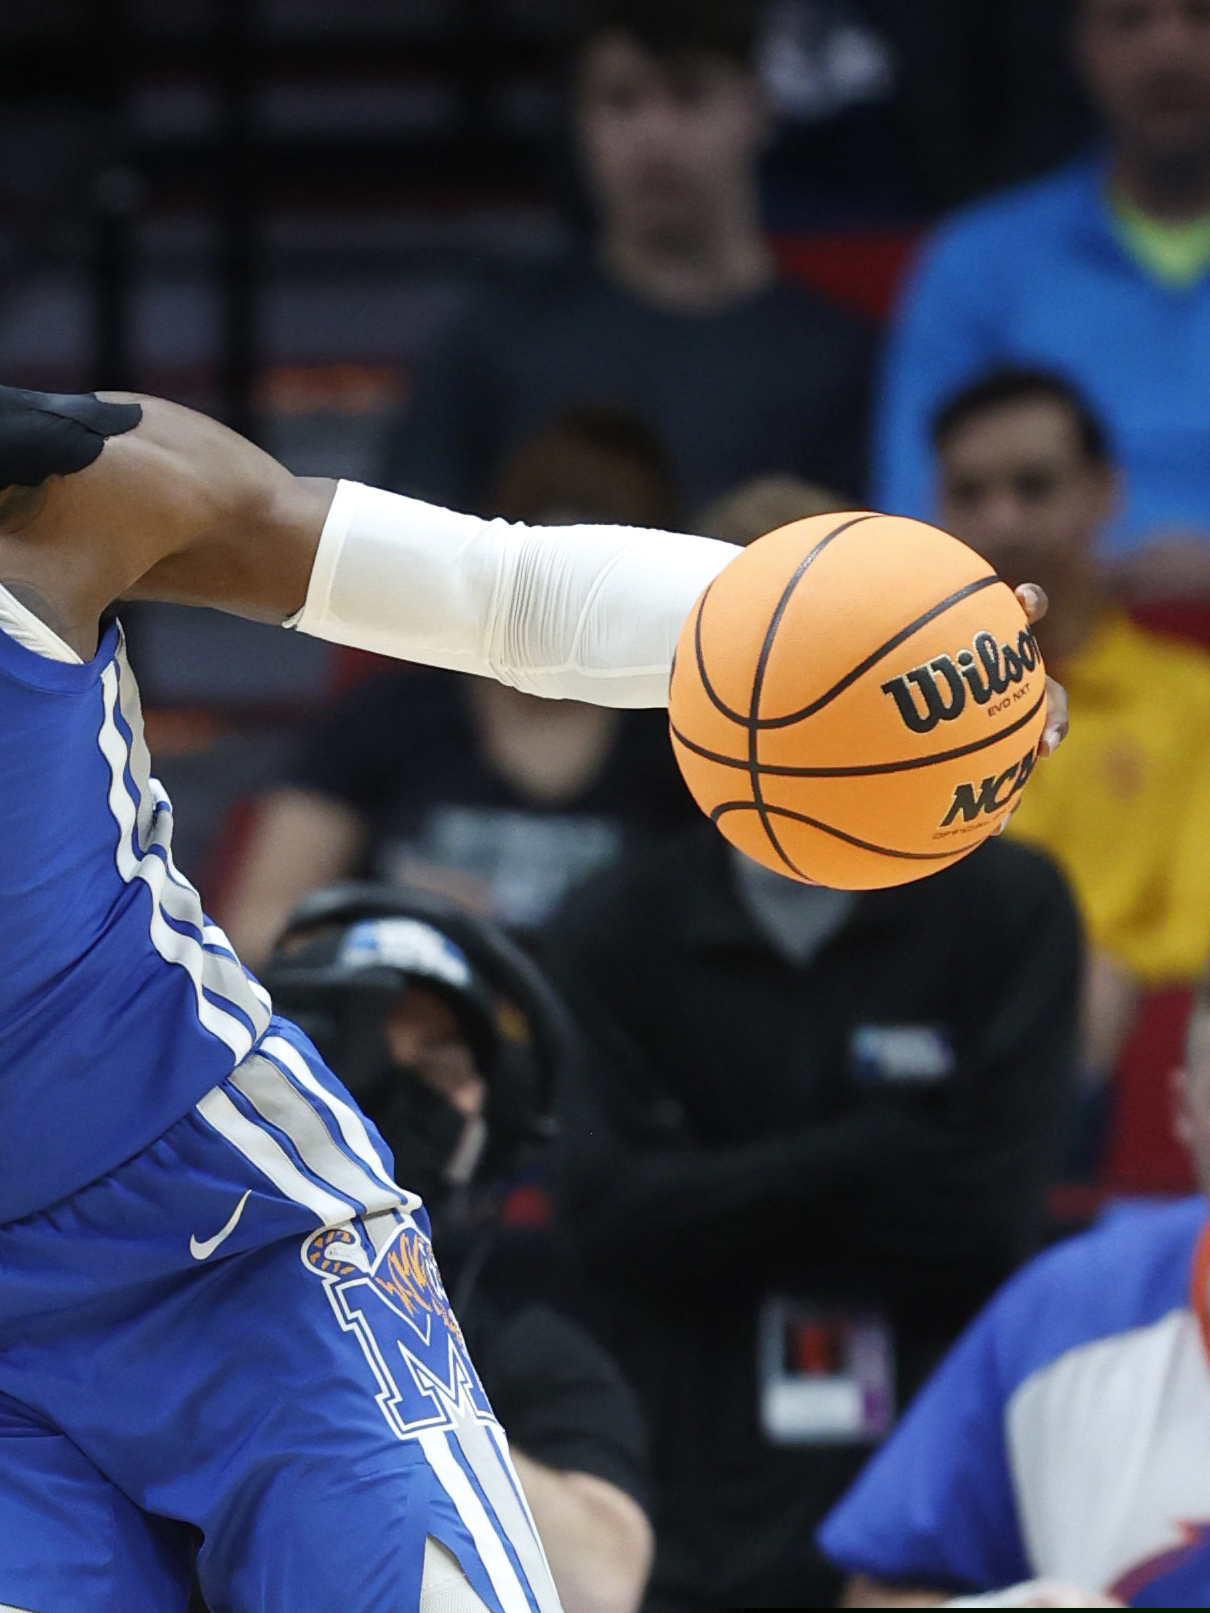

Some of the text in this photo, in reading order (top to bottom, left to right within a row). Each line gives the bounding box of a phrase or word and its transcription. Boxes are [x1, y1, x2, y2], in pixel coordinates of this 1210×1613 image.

[880, 624, 1041, 734] Wilso
[987, 682, 1030, 717] EVO NXT
[939, 745, 1036, 828] NCA
